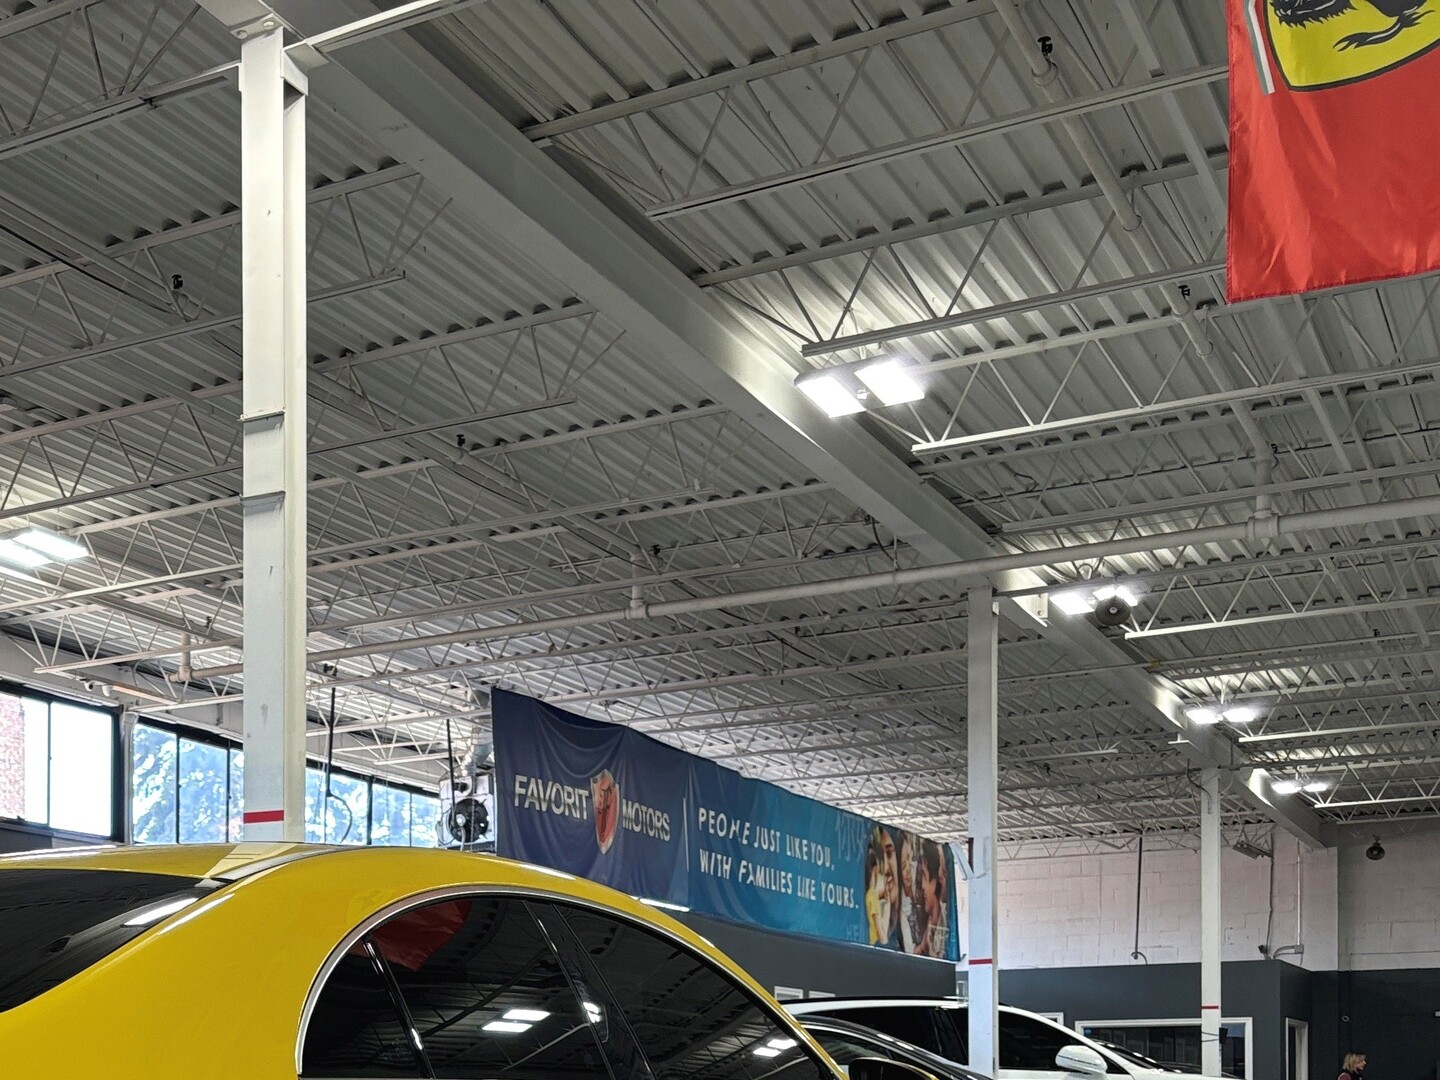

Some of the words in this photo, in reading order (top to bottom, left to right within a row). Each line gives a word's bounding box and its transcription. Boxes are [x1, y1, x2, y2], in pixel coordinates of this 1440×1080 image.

[514, 774, 589, 820] FAVORIT
[622, 799, 671, 842] MOTORS
[699, 848, 732, 880] WITH
[738, 860, 793, 895] FAMILIES
[797, 875, 816, 901] LIKE
[820, 881, 859, 909] YOURS.
[754, 825, 781, 853] JUST
[786, 834, 808, 861] LIKE
[810, 841, 835, 871] YOU,
